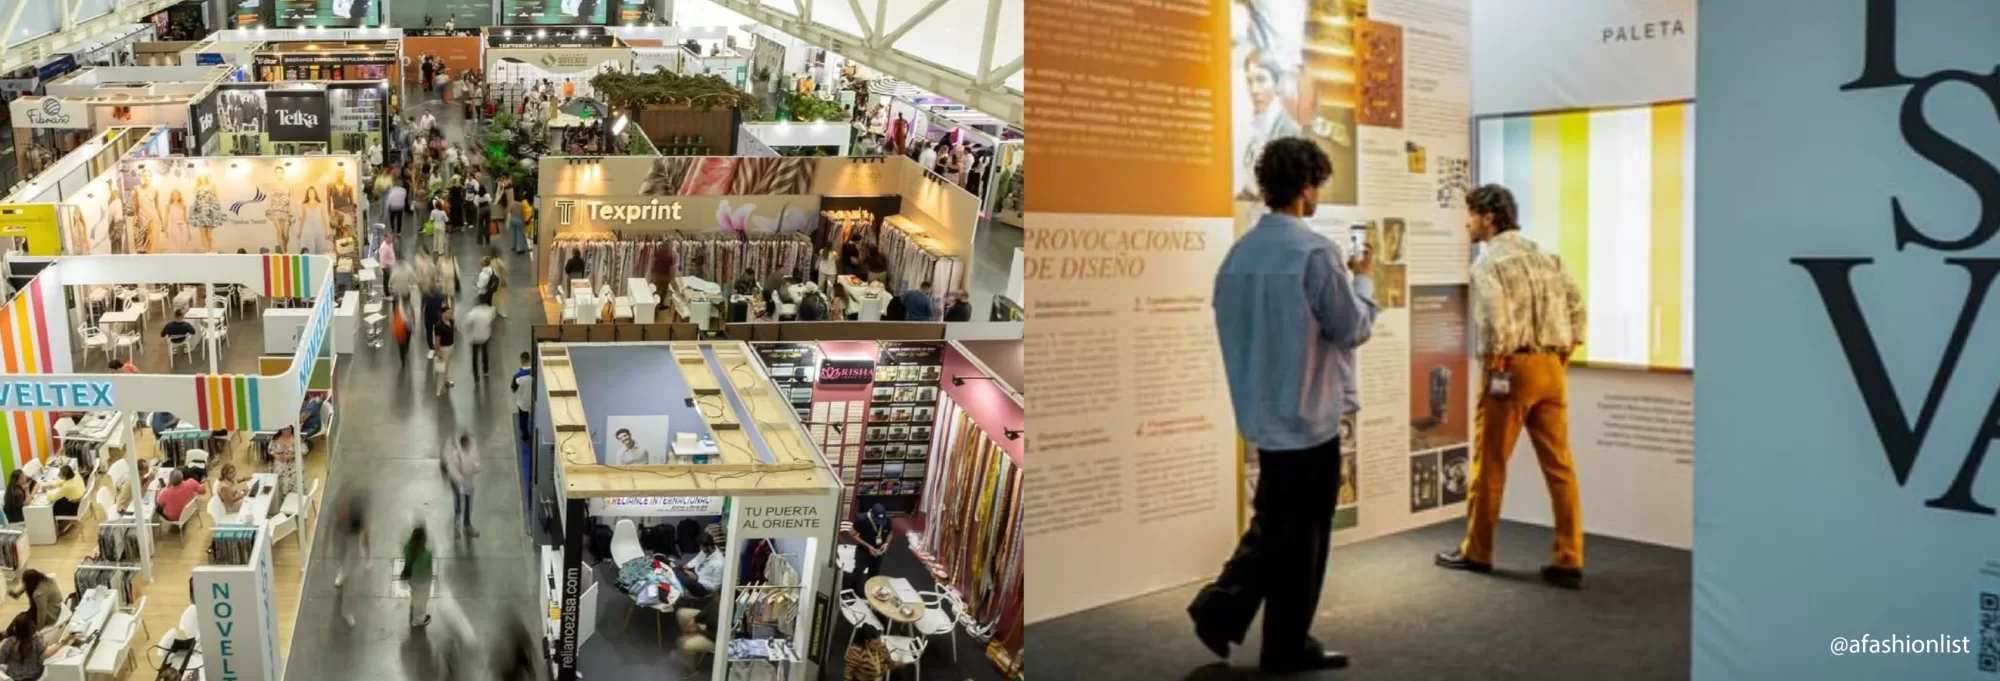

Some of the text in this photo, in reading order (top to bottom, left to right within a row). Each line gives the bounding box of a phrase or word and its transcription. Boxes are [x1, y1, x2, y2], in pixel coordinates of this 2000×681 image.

[1602, 18, 1685, 44] PALETA
[587, 199, 682, 225] Texprint
[1024, 229, 1206, 251] PROVOCACIONES
[1024, 251, 1145, 279] DE DISEÑO
[743, 518, 820, 529] AL ORIENTE
[745, 506, 818, 517] TU PUERTA
[212, 583, 237, 681] NOVEL
